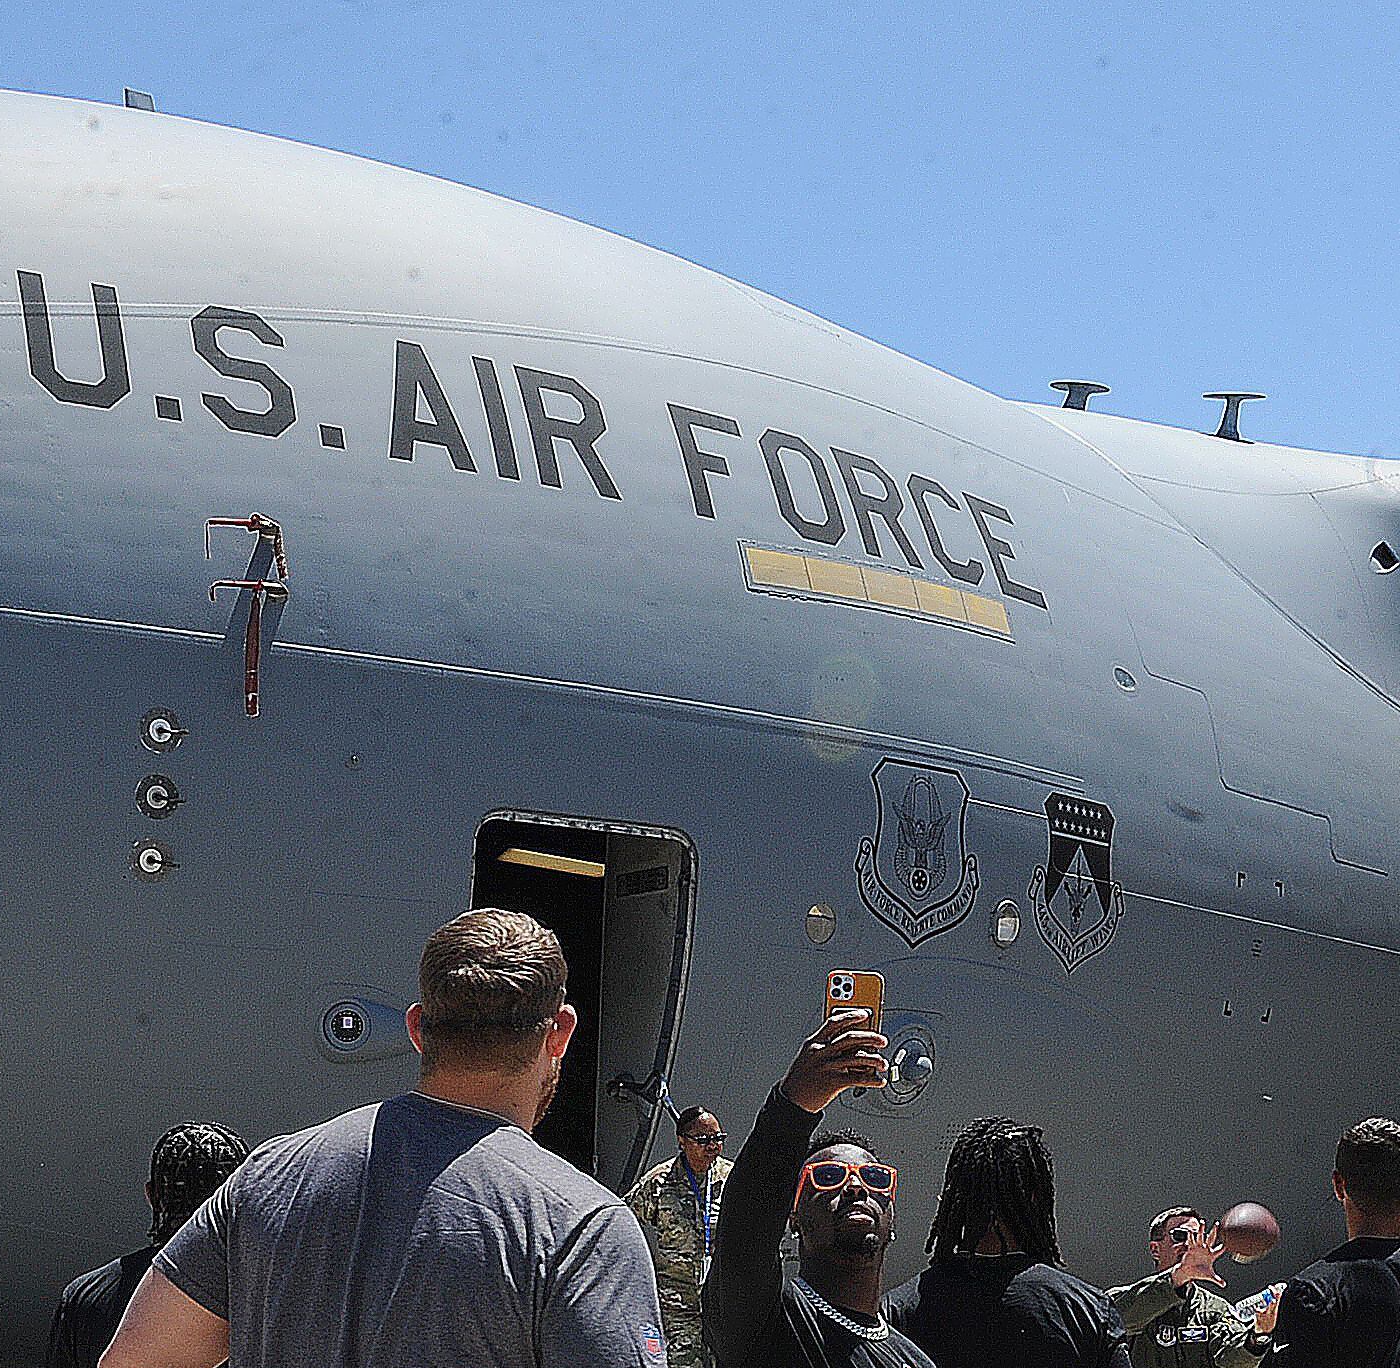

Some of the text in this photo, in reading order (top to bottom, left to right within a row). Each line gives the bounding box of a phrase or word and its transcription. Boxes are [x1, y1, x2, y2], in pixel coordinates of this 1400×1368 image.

[16, 269, 1048, 610] U.S. AIR FORCE
[863, 870, 876, 897] AIR
[874, 890, 900, 919] FORCE
[936, 883, 973, 922] COMMAND
